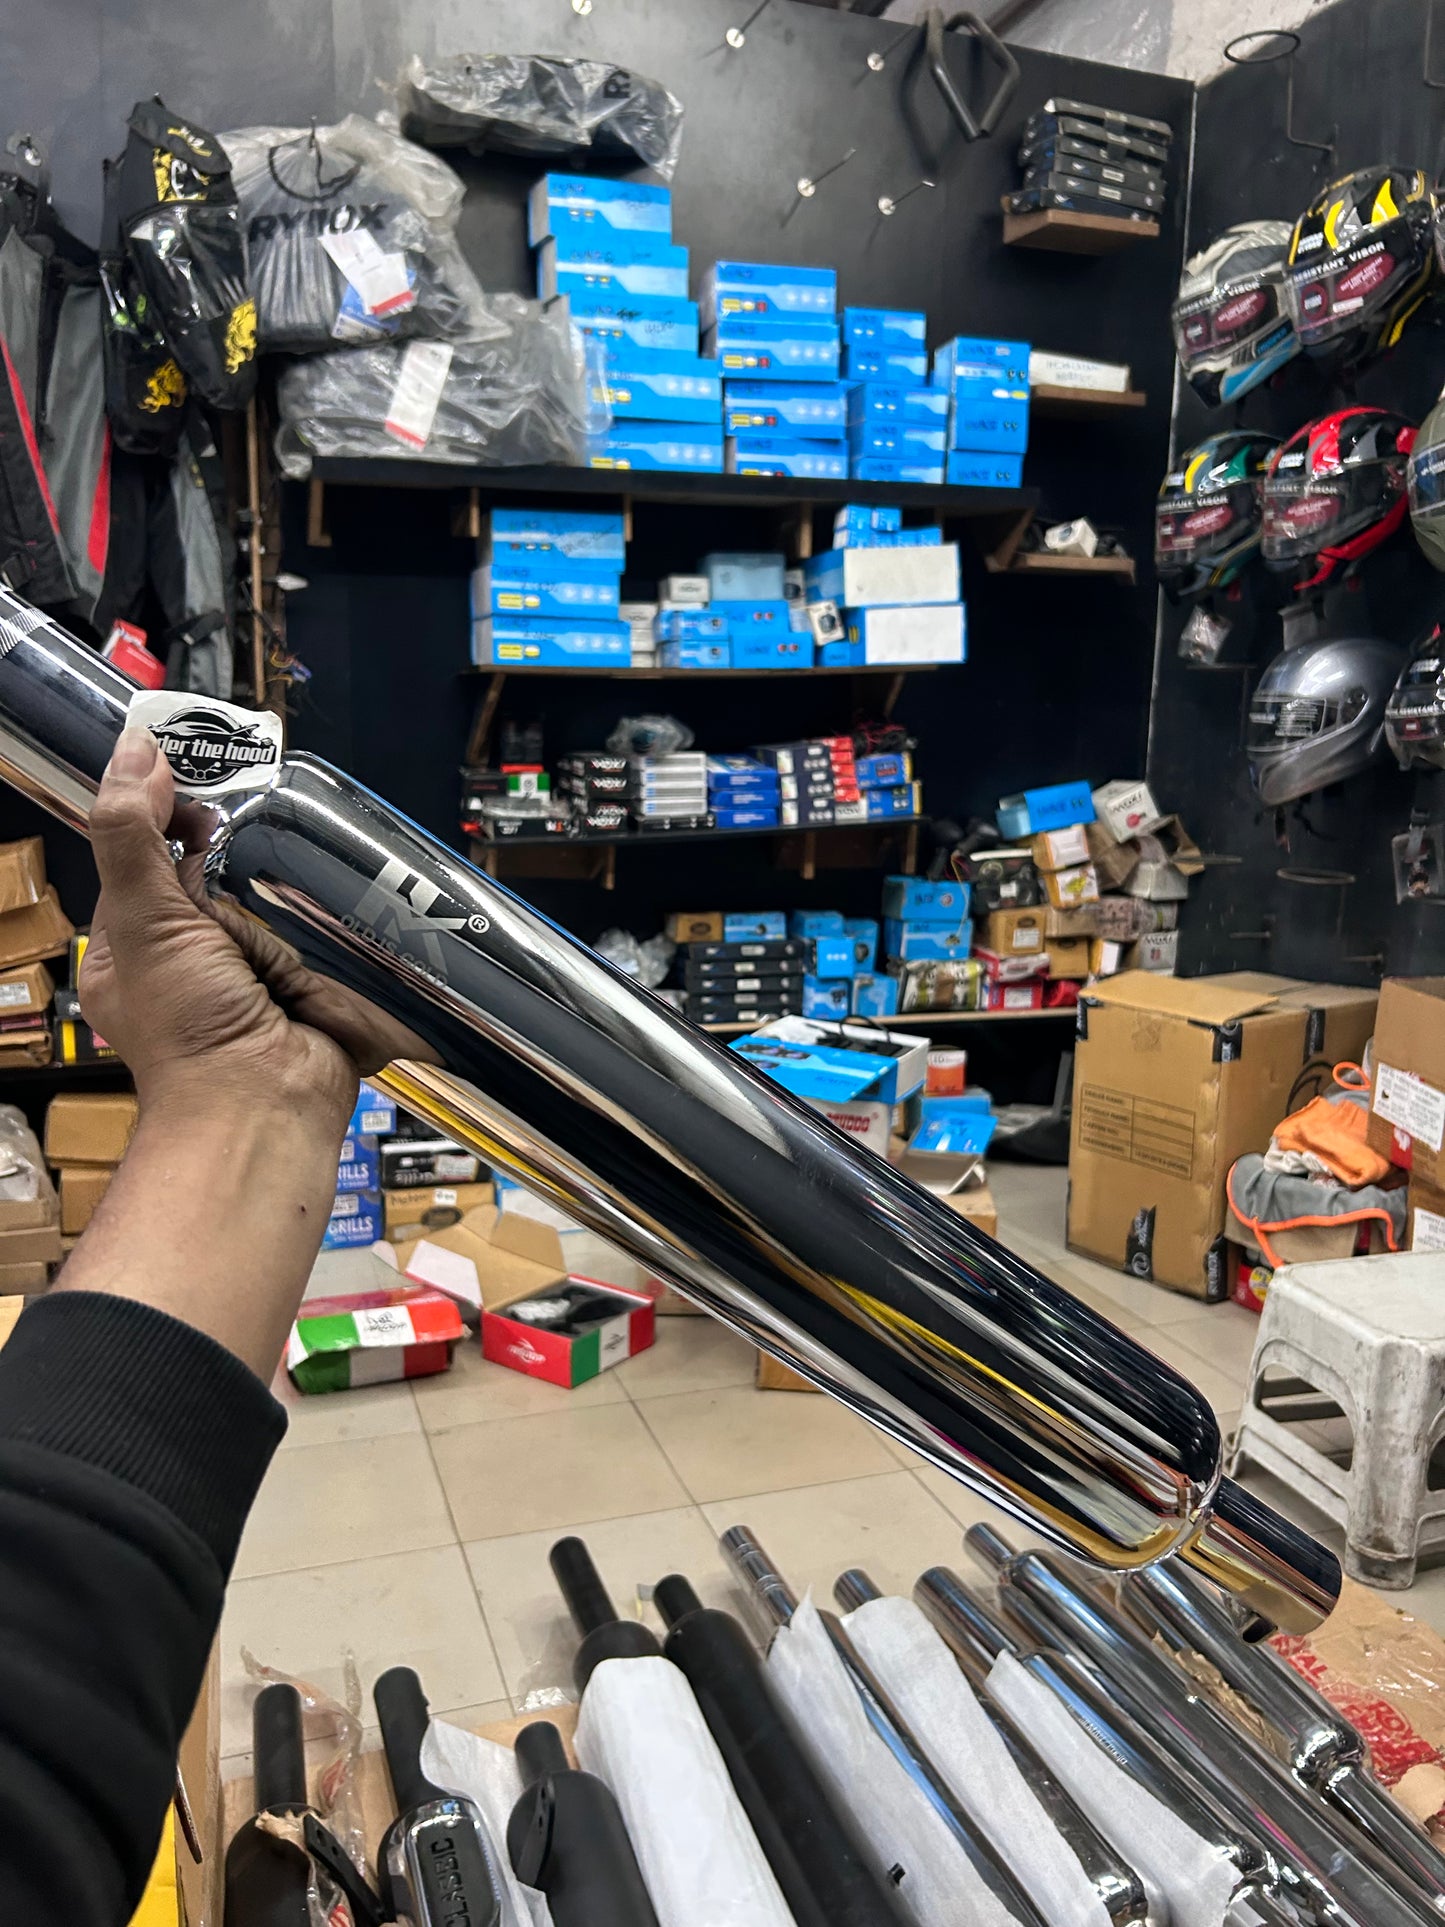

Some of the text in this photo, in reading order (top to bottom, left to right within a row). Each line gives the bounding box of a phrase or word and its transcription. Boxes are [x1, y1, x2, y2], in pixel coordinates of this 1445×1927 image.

[1349, 241, 1385, 262] VISOR
[156, 735, 275, 763] der the hood
[340, 913, 449, 989] OLD IS GOLD
[338, 1162, 369, 1181] RILLS
[328, 1215, 374, 1234] GRILLS
